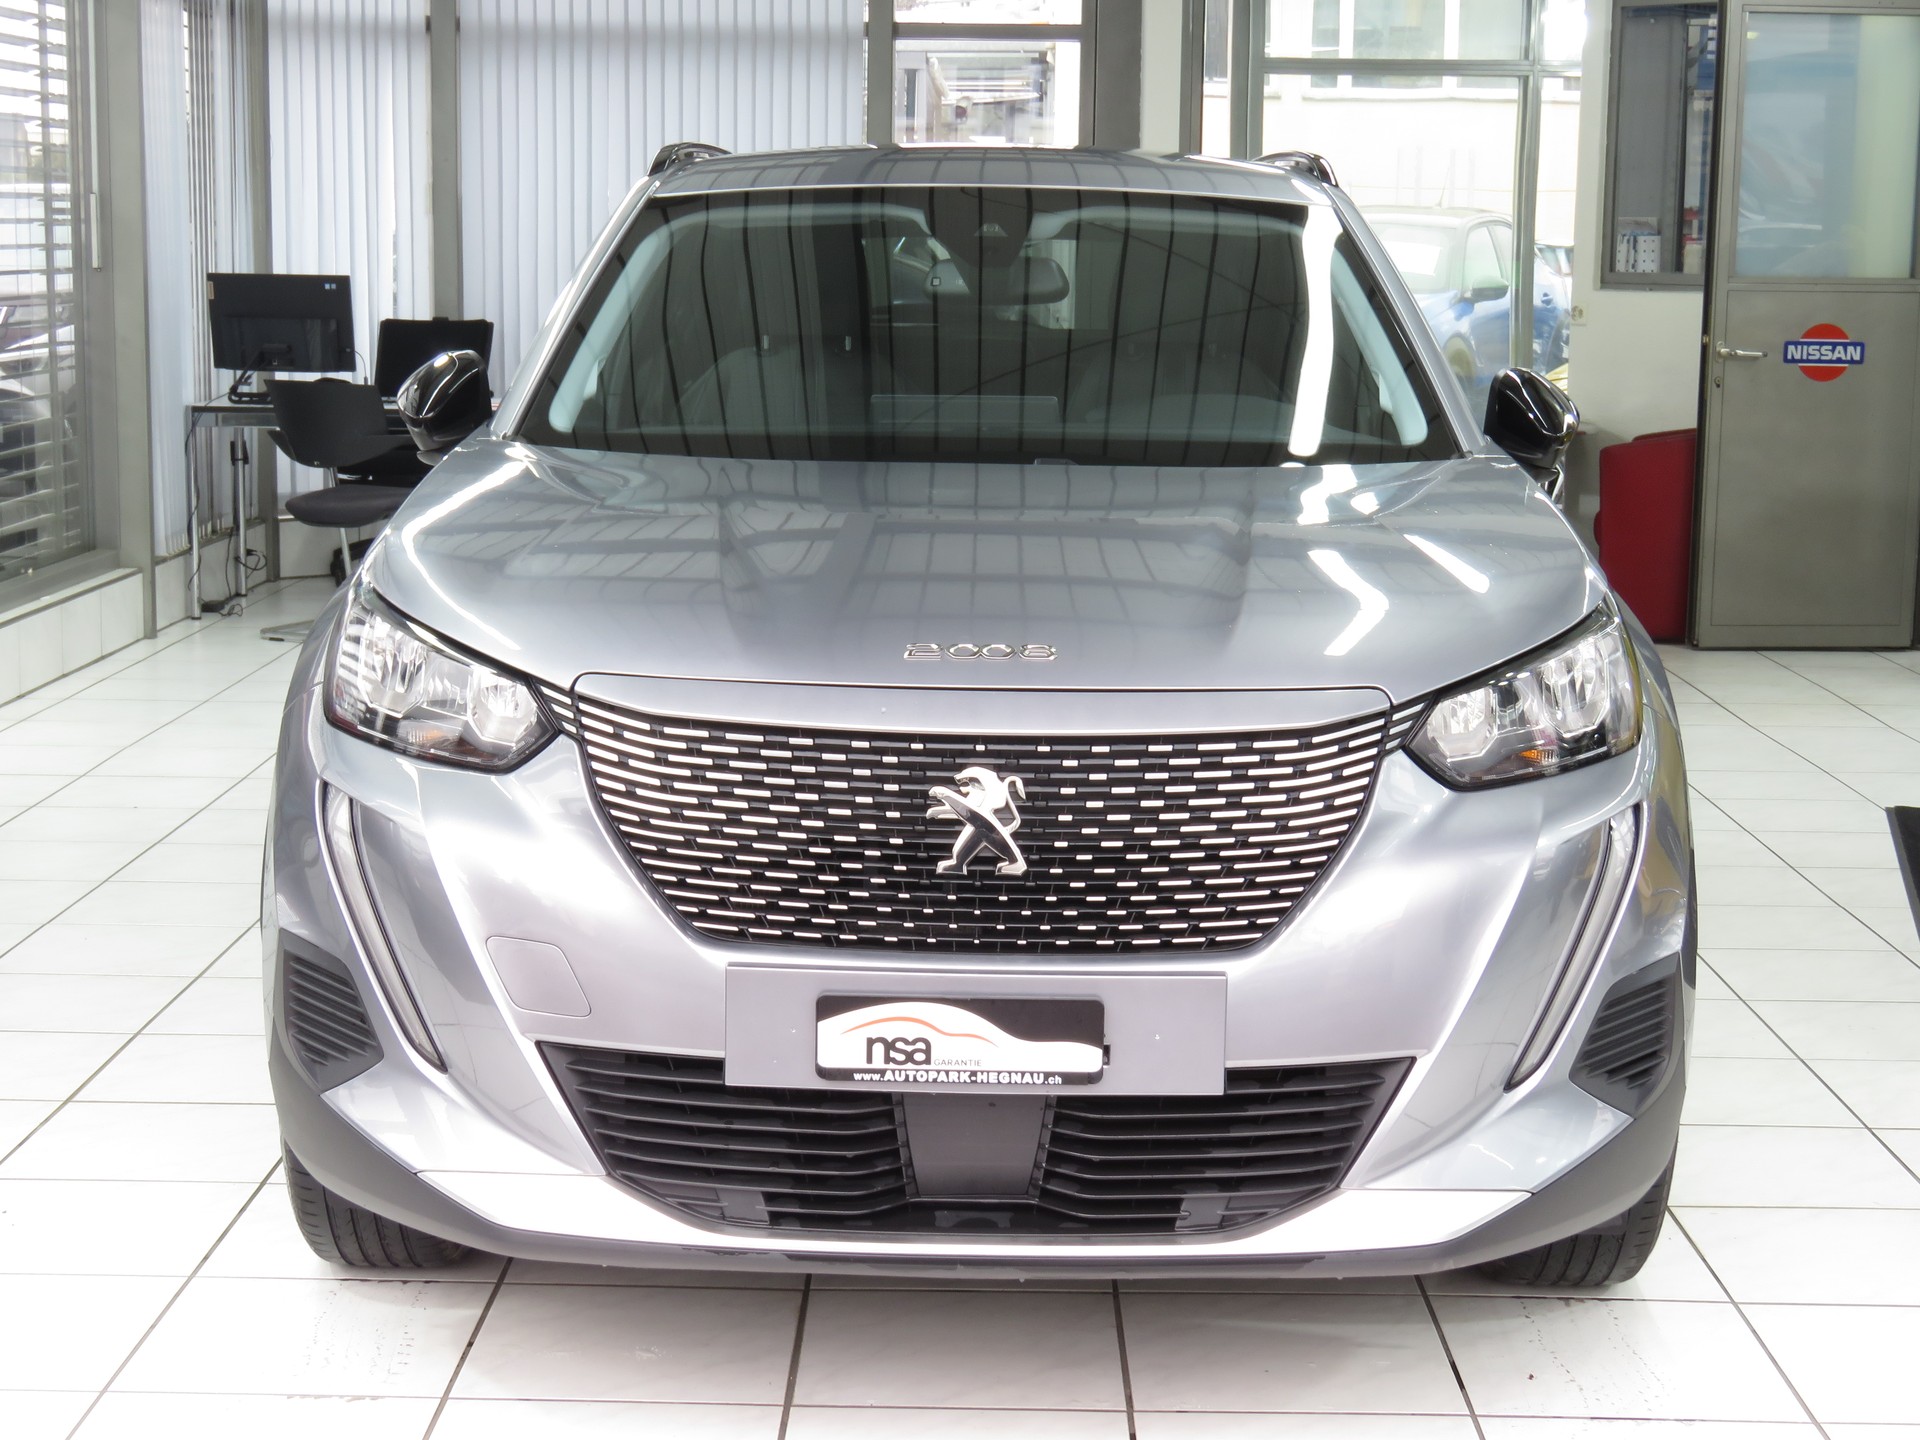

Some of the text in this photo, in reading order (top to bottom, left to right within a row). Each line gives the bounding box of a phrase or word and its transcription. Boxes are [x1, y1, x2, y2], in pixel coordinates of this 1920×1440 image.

[1786, 344, 1862, 361] NISSAN
[903, 643, 1058, 661] 2008
[866, 1036, 932, 1066] nsa
[933, 1058, 982, 1067] GARANTIE
[853, 1069, 1063, 1086] www.AUTOPARK-HEGNAU.ch
